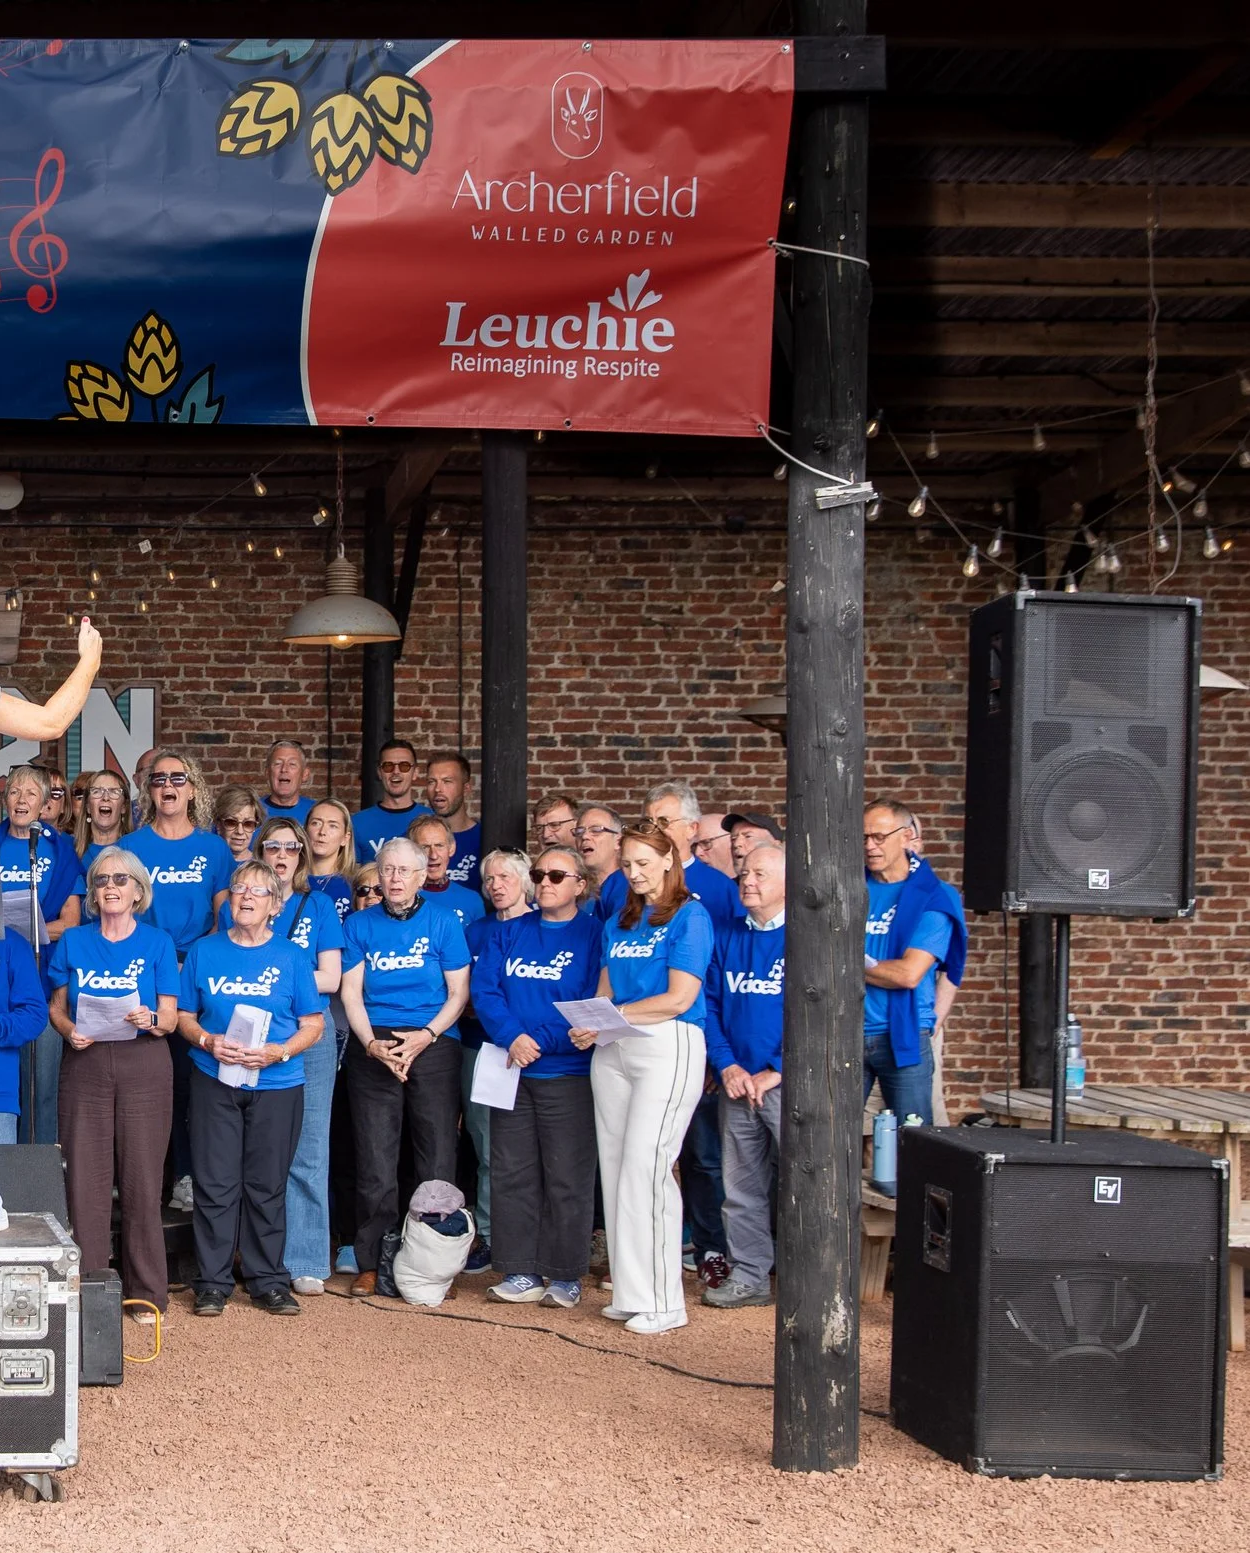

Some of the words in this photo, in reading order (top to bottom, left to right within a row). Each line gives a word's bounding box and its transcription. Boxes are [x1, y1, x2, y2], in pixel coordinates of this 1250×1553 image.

[451, 169, 698, 218] Archerfield
[471, 224, 567, 243] WALLED
[577, 228, 674, 246] GARDEN
[439, 301, 676, 353] Leuchie
[451, 352, 577, 379] Reimagining
[584, 356, 661, 380] Respite
[0, 865, 42, 882] oices
[610, 940, 655, 958] Voices
[76, 968, 138, 990] Voices
[505, 957, 562, 981] Voices
[208, 975, 272, 997] Voices
[726, 971, 782, 995] Voices
